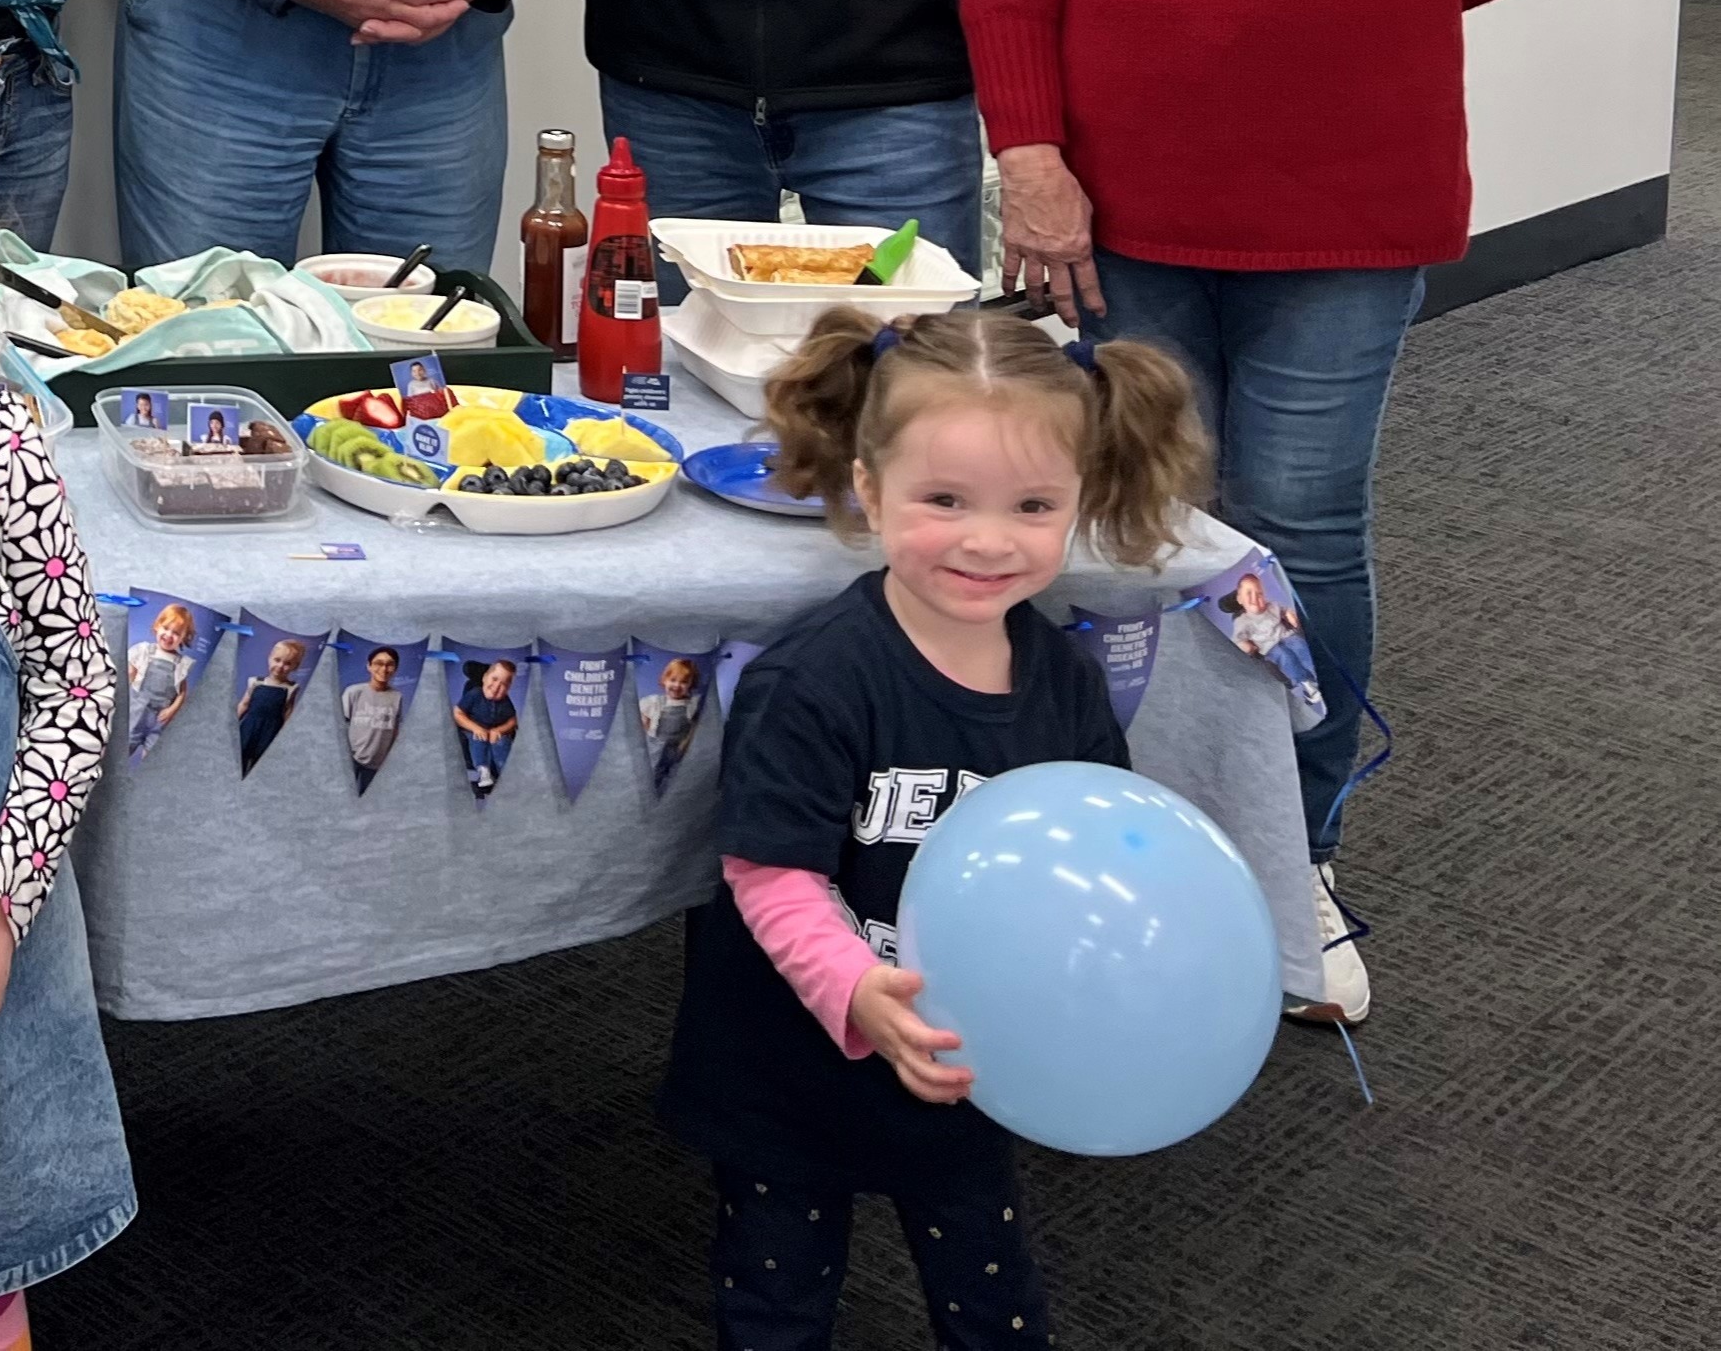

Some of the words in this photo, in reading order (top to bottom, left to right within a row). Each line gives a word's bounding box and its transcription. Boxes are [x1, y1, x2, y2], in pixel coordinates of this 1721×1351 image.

[580, 659, 607, 671] FIGHT
[564, 670, 615, 683] CHILDREN'S
[570, 683, 609, 695] GENETIC
[566, 694, 609, 706] DISEASES
